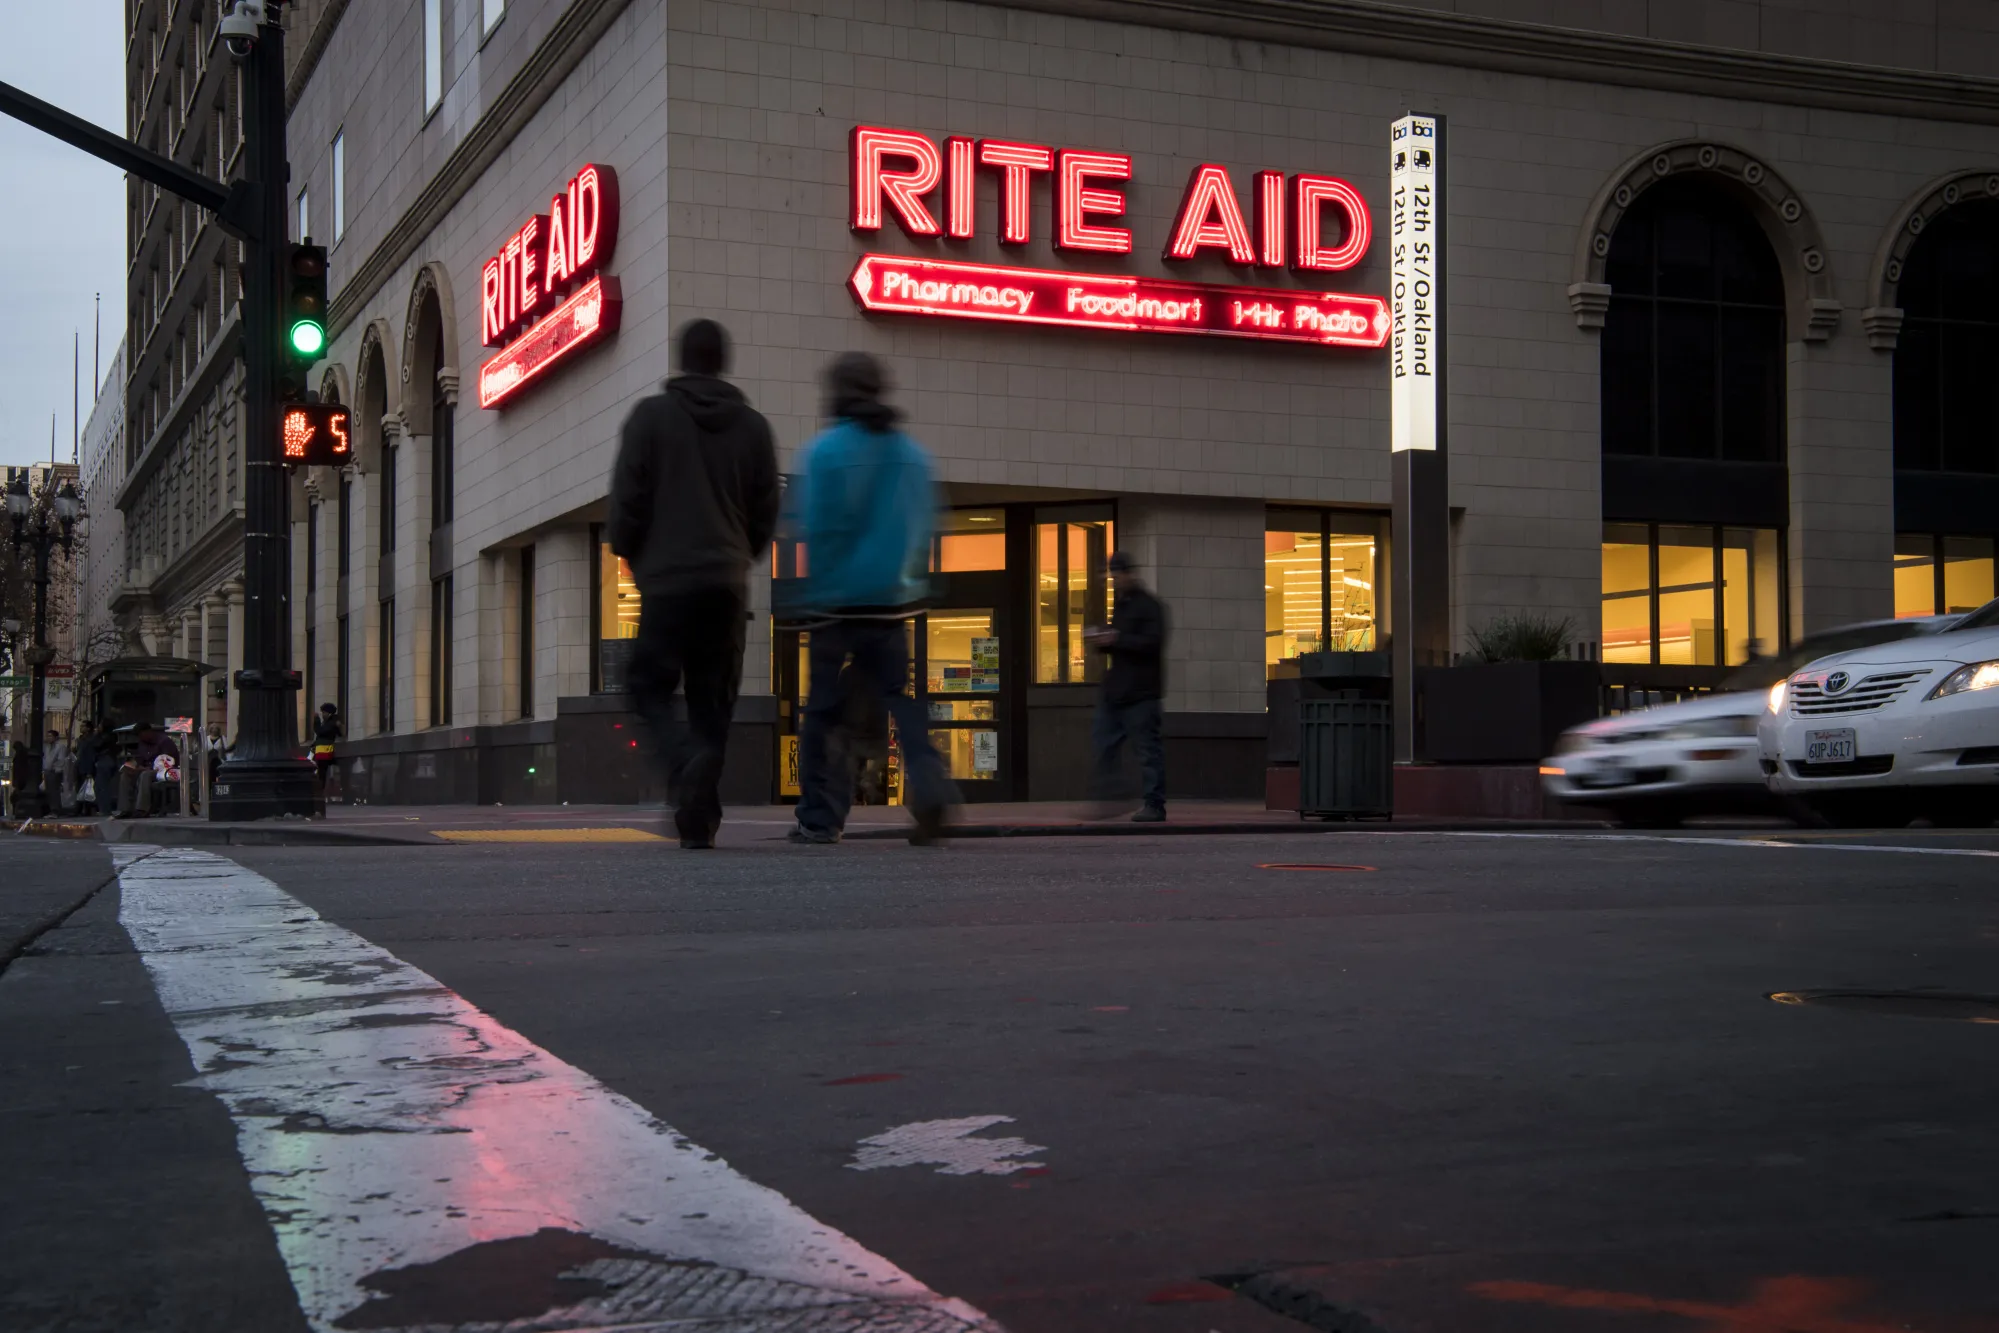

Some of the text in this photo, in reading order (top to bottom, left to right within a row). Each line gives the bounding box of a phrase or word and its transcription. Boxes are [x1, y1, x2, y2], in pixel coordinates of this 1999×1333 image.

[848, 125, 1373, 273] RITE AID
[1393, 185, 1406, 236] 12th
[1413, 184, 1431, 232] 12th
[481, 163, 608, 347] RITE AID
[883, 271, 1369, 335] Pharmacy Foodmart 1-Hr. Photo
[331, 413, 348, 453] 5
[1808, 741, 1851, 758] 6UPJ617
